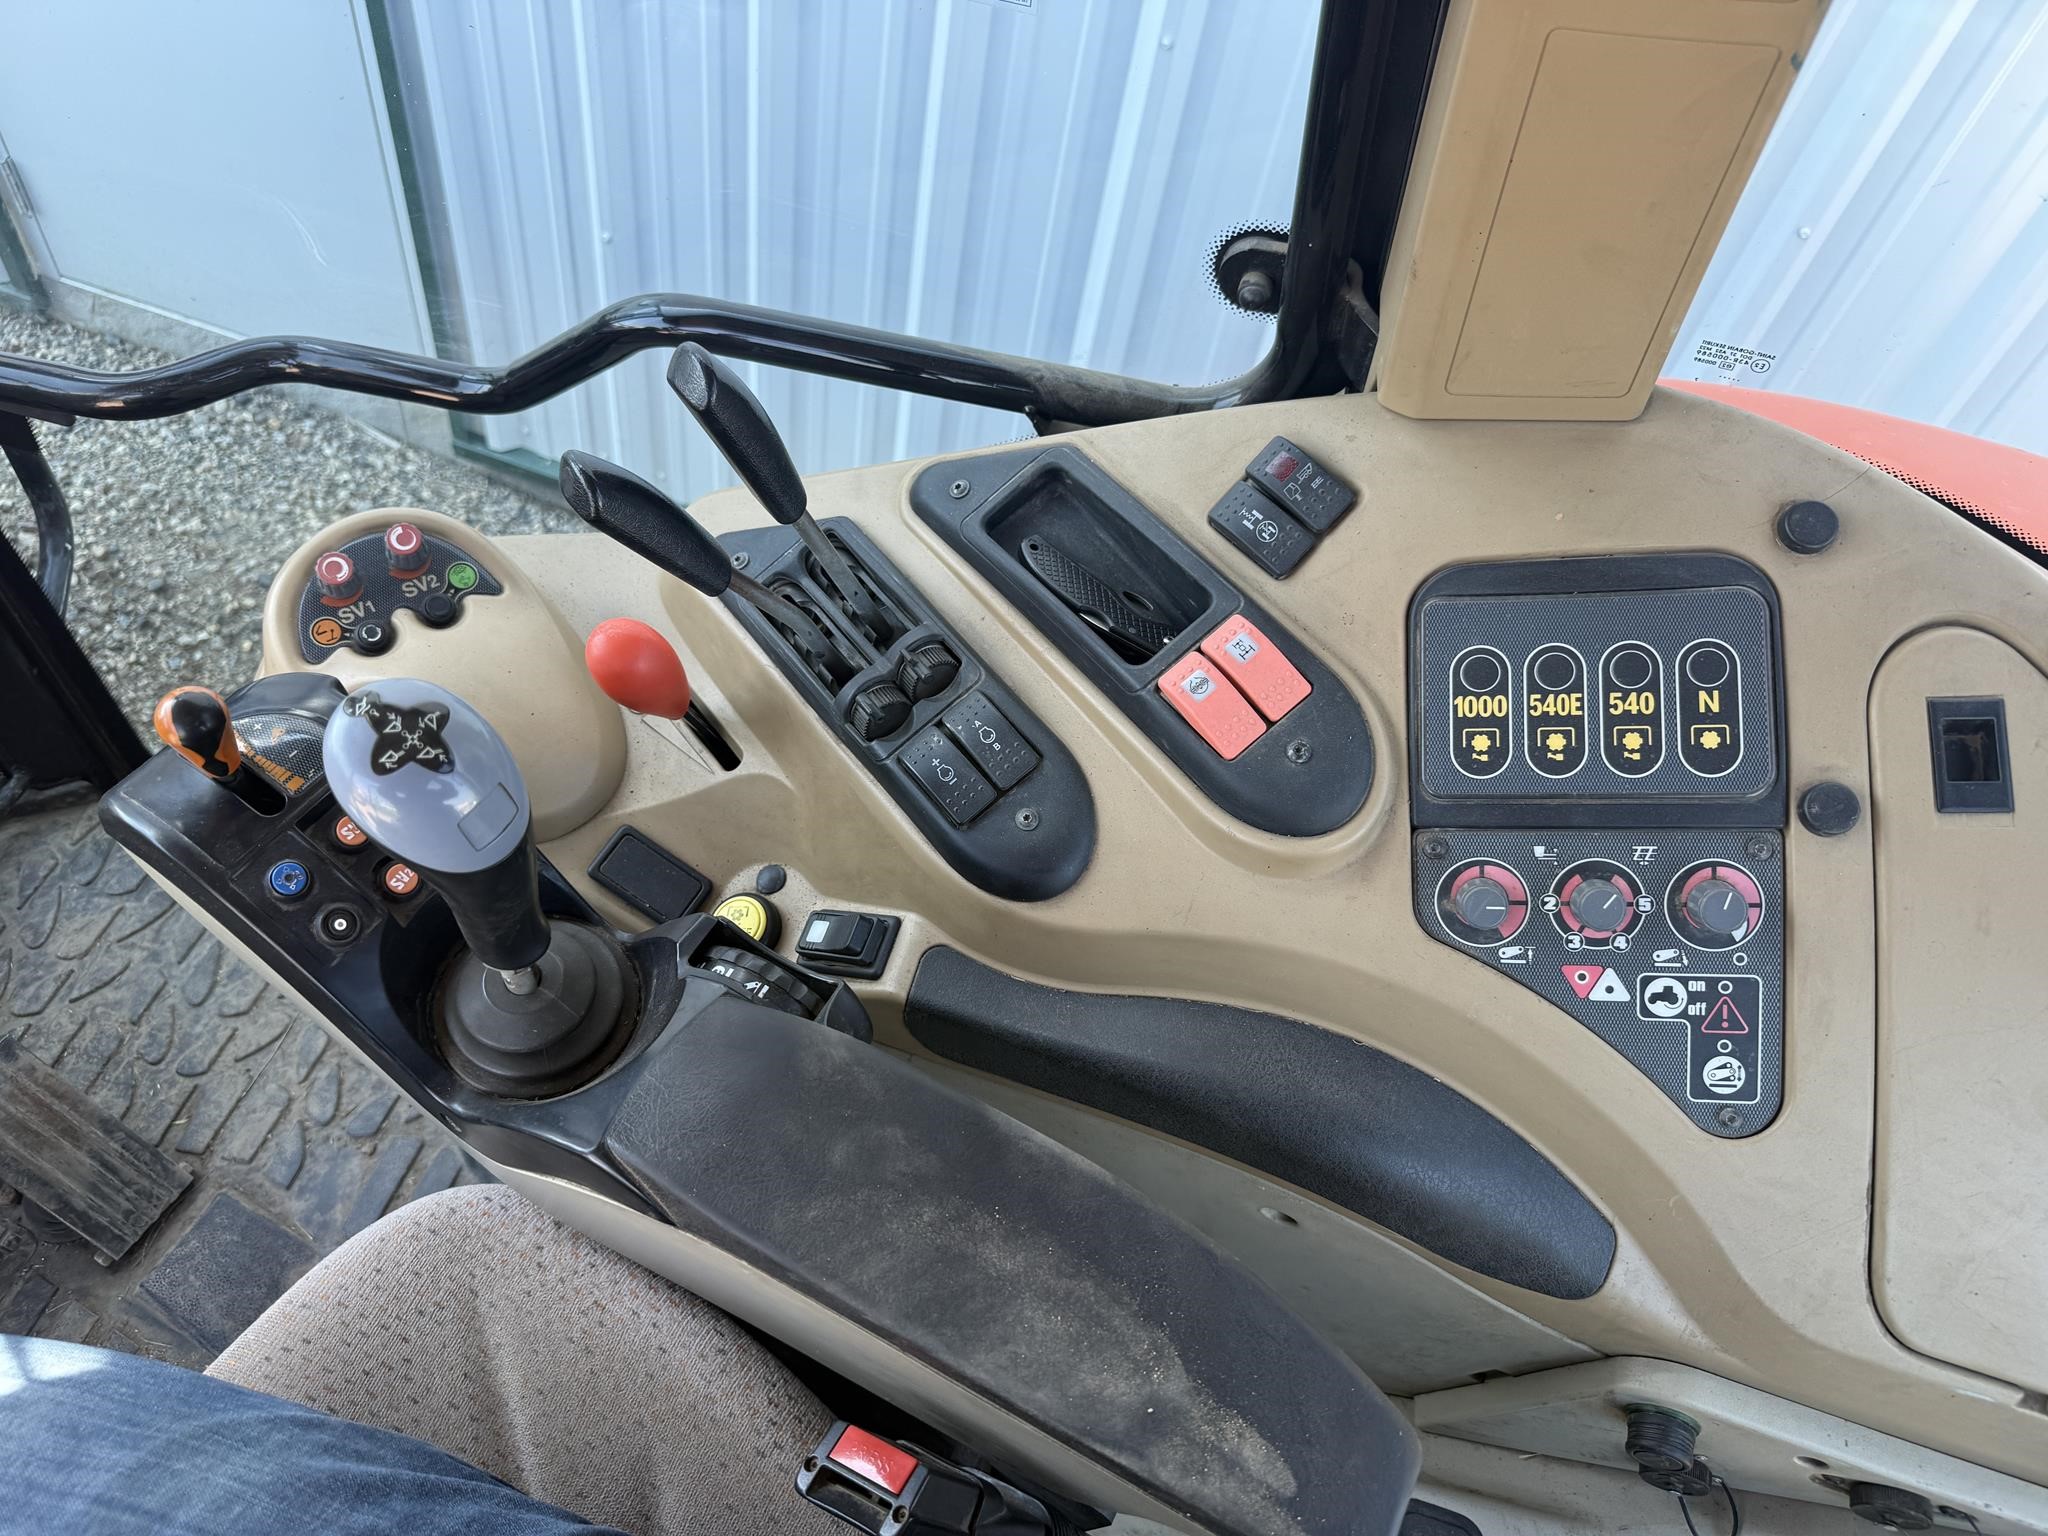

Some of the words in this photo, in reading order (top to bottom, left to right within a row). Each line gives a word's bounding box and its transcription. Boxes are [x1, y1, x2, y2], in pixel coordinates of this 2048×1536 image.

[402, 574, 440, 597] SV2
[338, 600, 376, 624] SV1
[1453, 694, 1508, 718] 1000
[1529, 693, 1583, 717] 540E
[1609, 691, 1655, 715] 540
[1698, 690, 1720, 713] N
[1543, 897, 1557, 910] 2
[1638, 898, 1652, 911] 5
[1568, 936, 1582, 950] 3
[1613, 936, 1628, 949] 4
[1688, 981, 1706, 991] on
[1688, 1002, 1706, 1015] off
